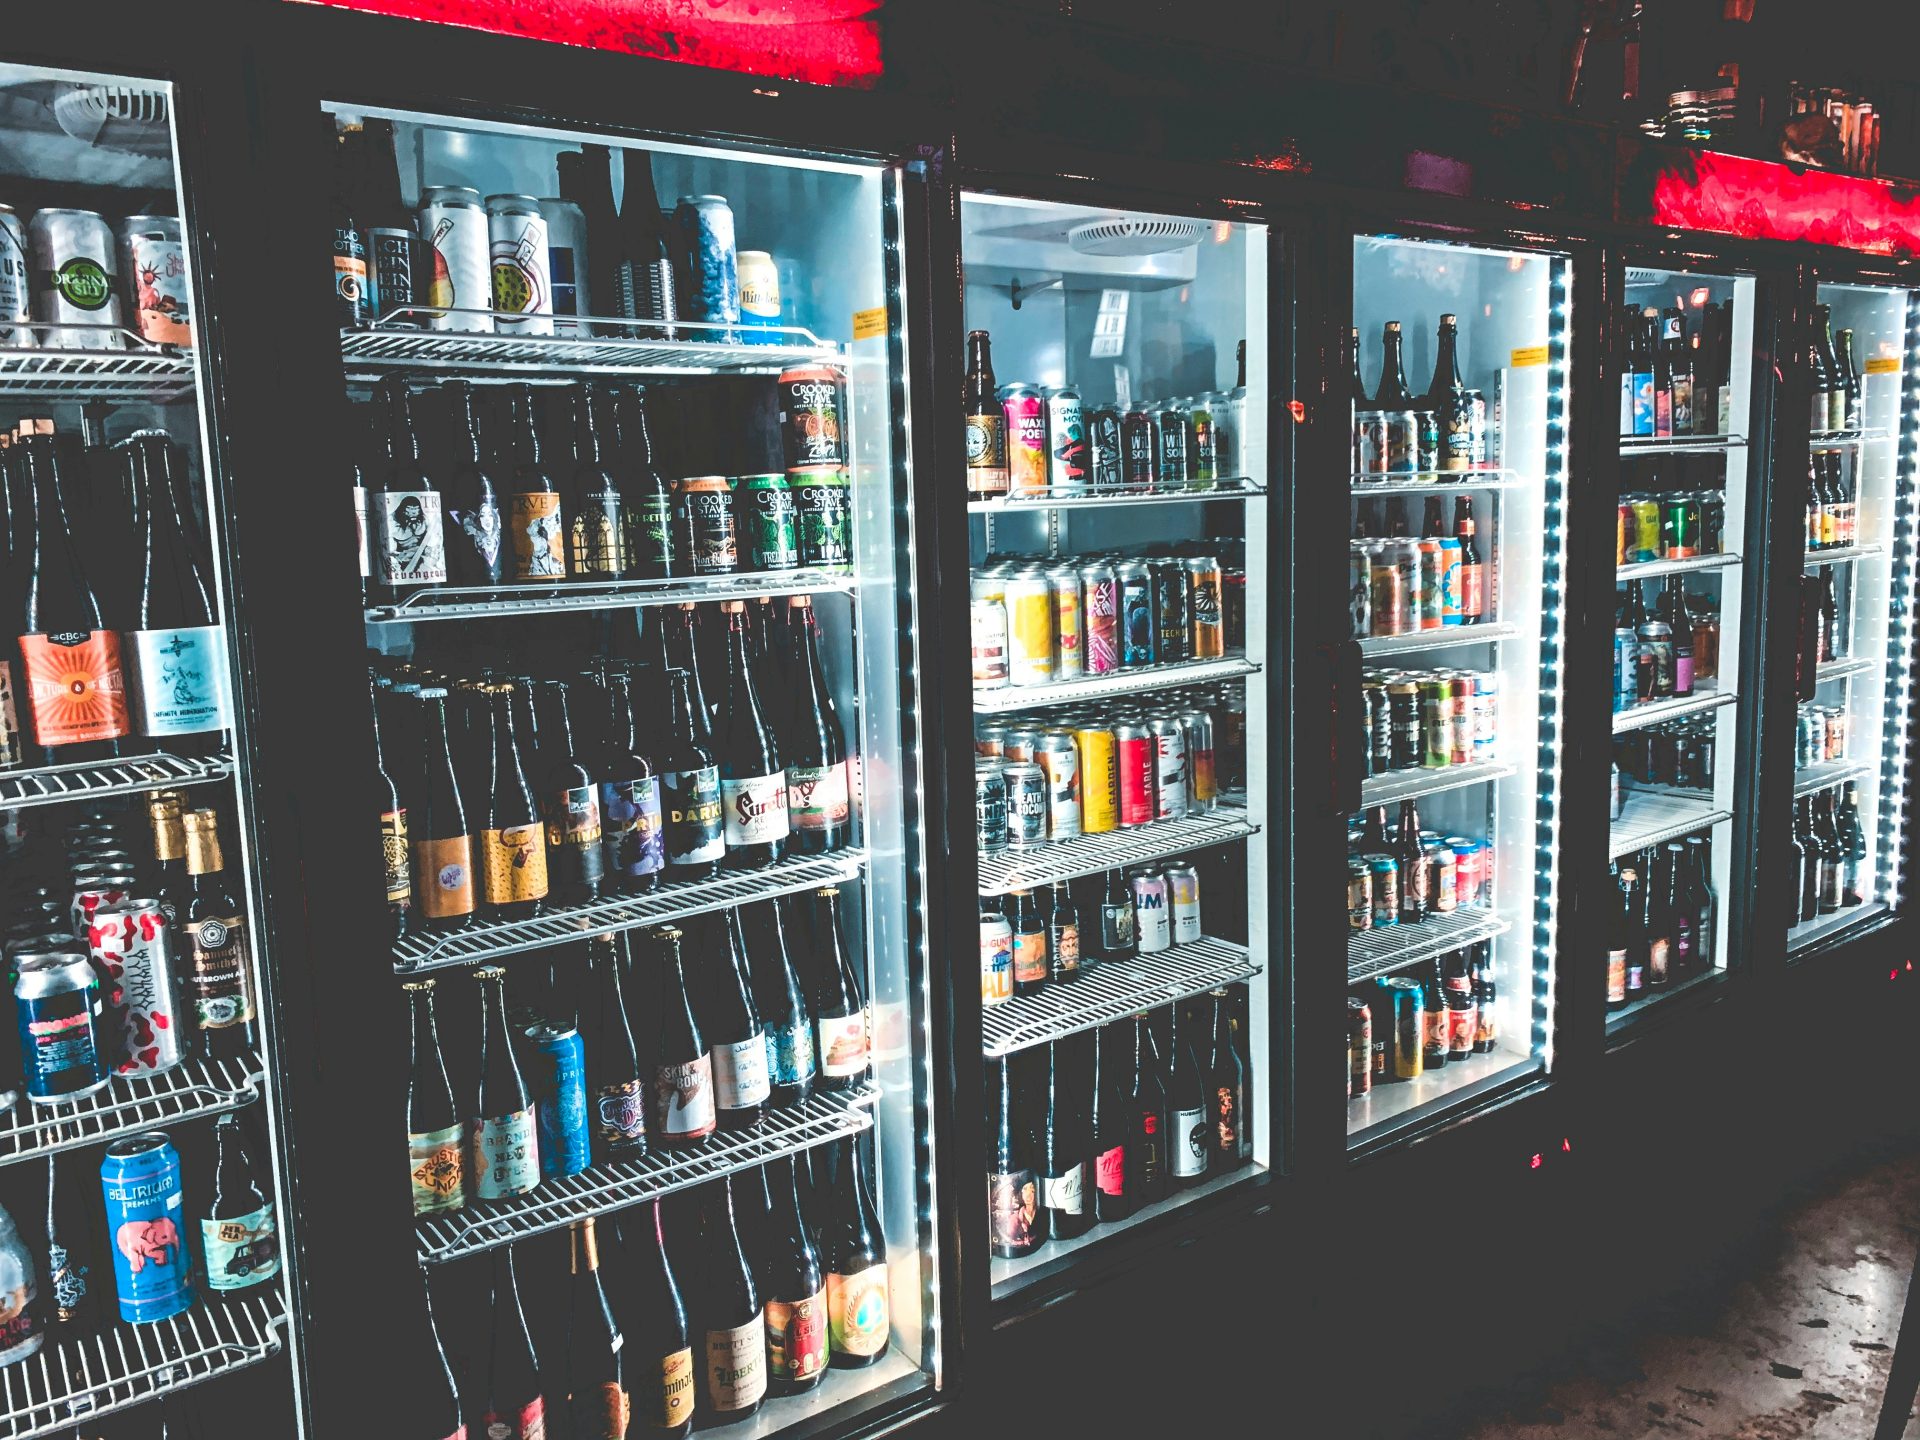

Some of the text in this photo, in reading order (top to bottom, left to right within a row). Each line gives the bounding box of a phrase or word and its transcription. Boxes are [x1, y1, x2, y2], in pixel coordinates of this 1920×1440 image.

[802, 393, 832, 404] STAVE
[59, 632, 81, 641] CBC
[1107, 755, 1117, 805] GARDEN
[1142, 761, 1152, 796] TABLE
[203, 973, 234, 983] BROWN
[663, 1063, 690, 1079] SKIN
[221, 1231, 239, 1240] TEA
